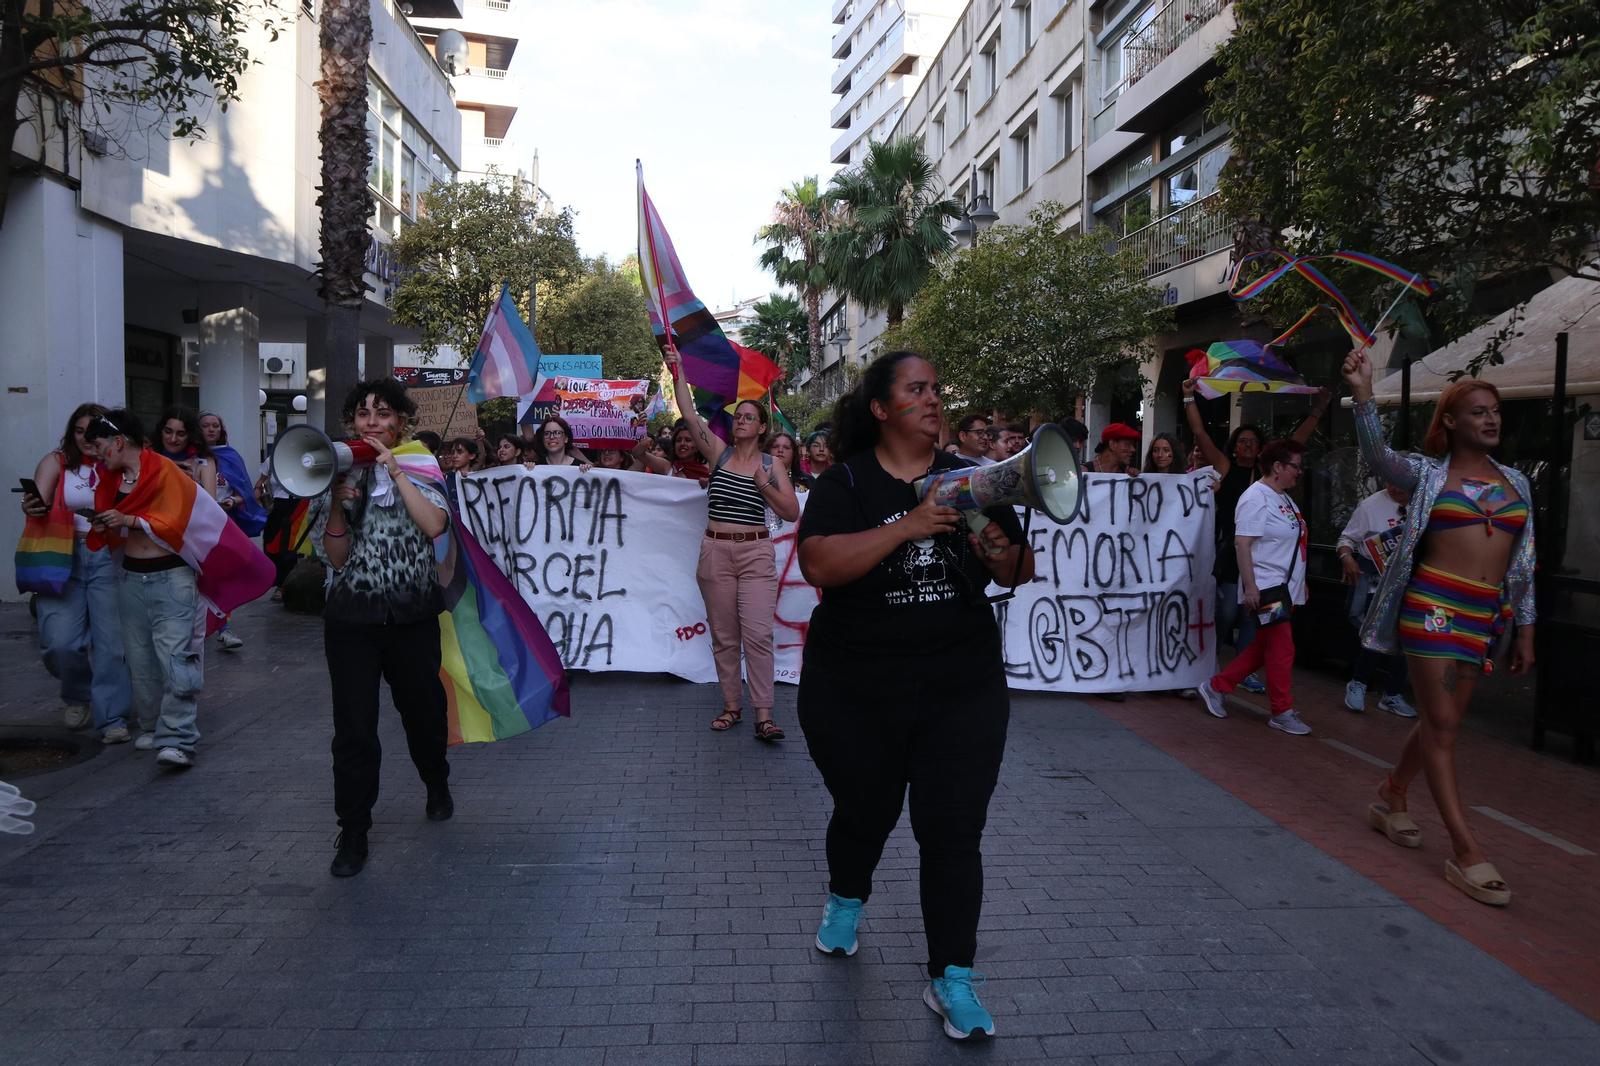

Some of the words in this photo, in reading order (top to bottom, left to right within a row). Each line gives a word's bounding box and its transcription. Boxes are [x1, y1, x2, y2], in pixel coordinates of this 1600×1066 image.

[562, 361, 573, 371] ES
[590, 409, 623, 419] LESBIANA
[591, 424, 603, 438] GO
[1176, 474, 1210, 518] DE
[461, 475, 627, 547] REFORMA
[1031, 527, 1195, 588] EMORIA
